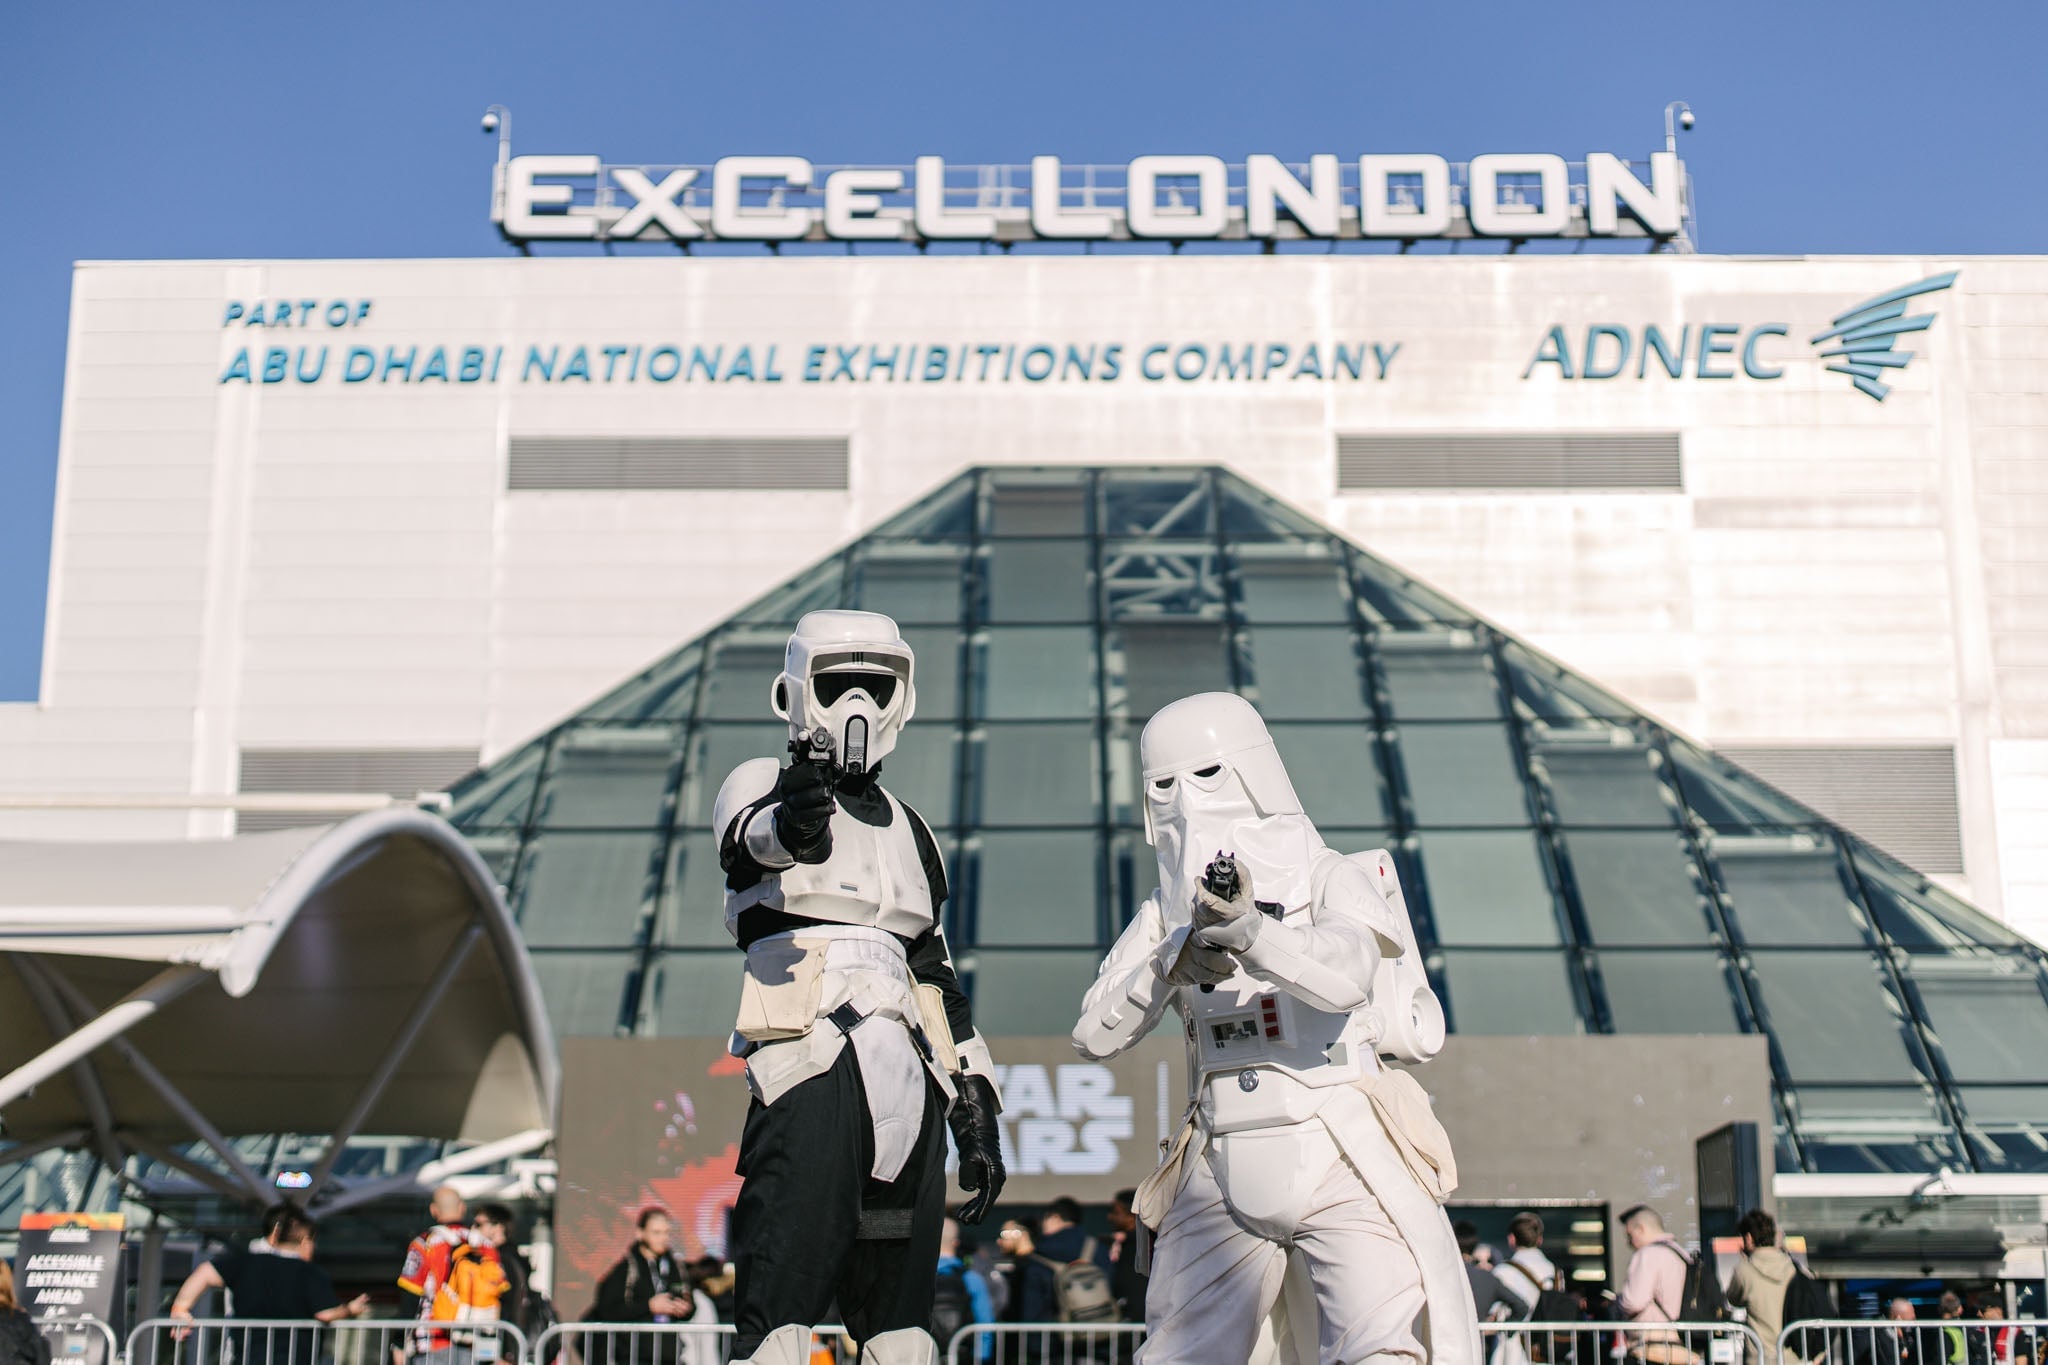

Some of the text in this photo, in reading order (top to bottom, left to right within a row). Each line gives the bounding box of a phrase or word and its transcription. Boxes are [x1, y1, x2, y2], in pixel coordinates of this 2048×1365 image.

[1032, 152, 1680, 238] LONDON
[223, 300, 371, 327] PART OF
[221, 343, 1401, 383] ABU DHABI NATIONAL EXHIBITIONS COMPANY
[1523, 325, 1788, 378] ADNEC
[26, 1254, 104, 1271] ACCESSIBLE
[26, 1271, 99, 1288] ENTRANCE
[34, 1288, 84, 1305] AHEAD
